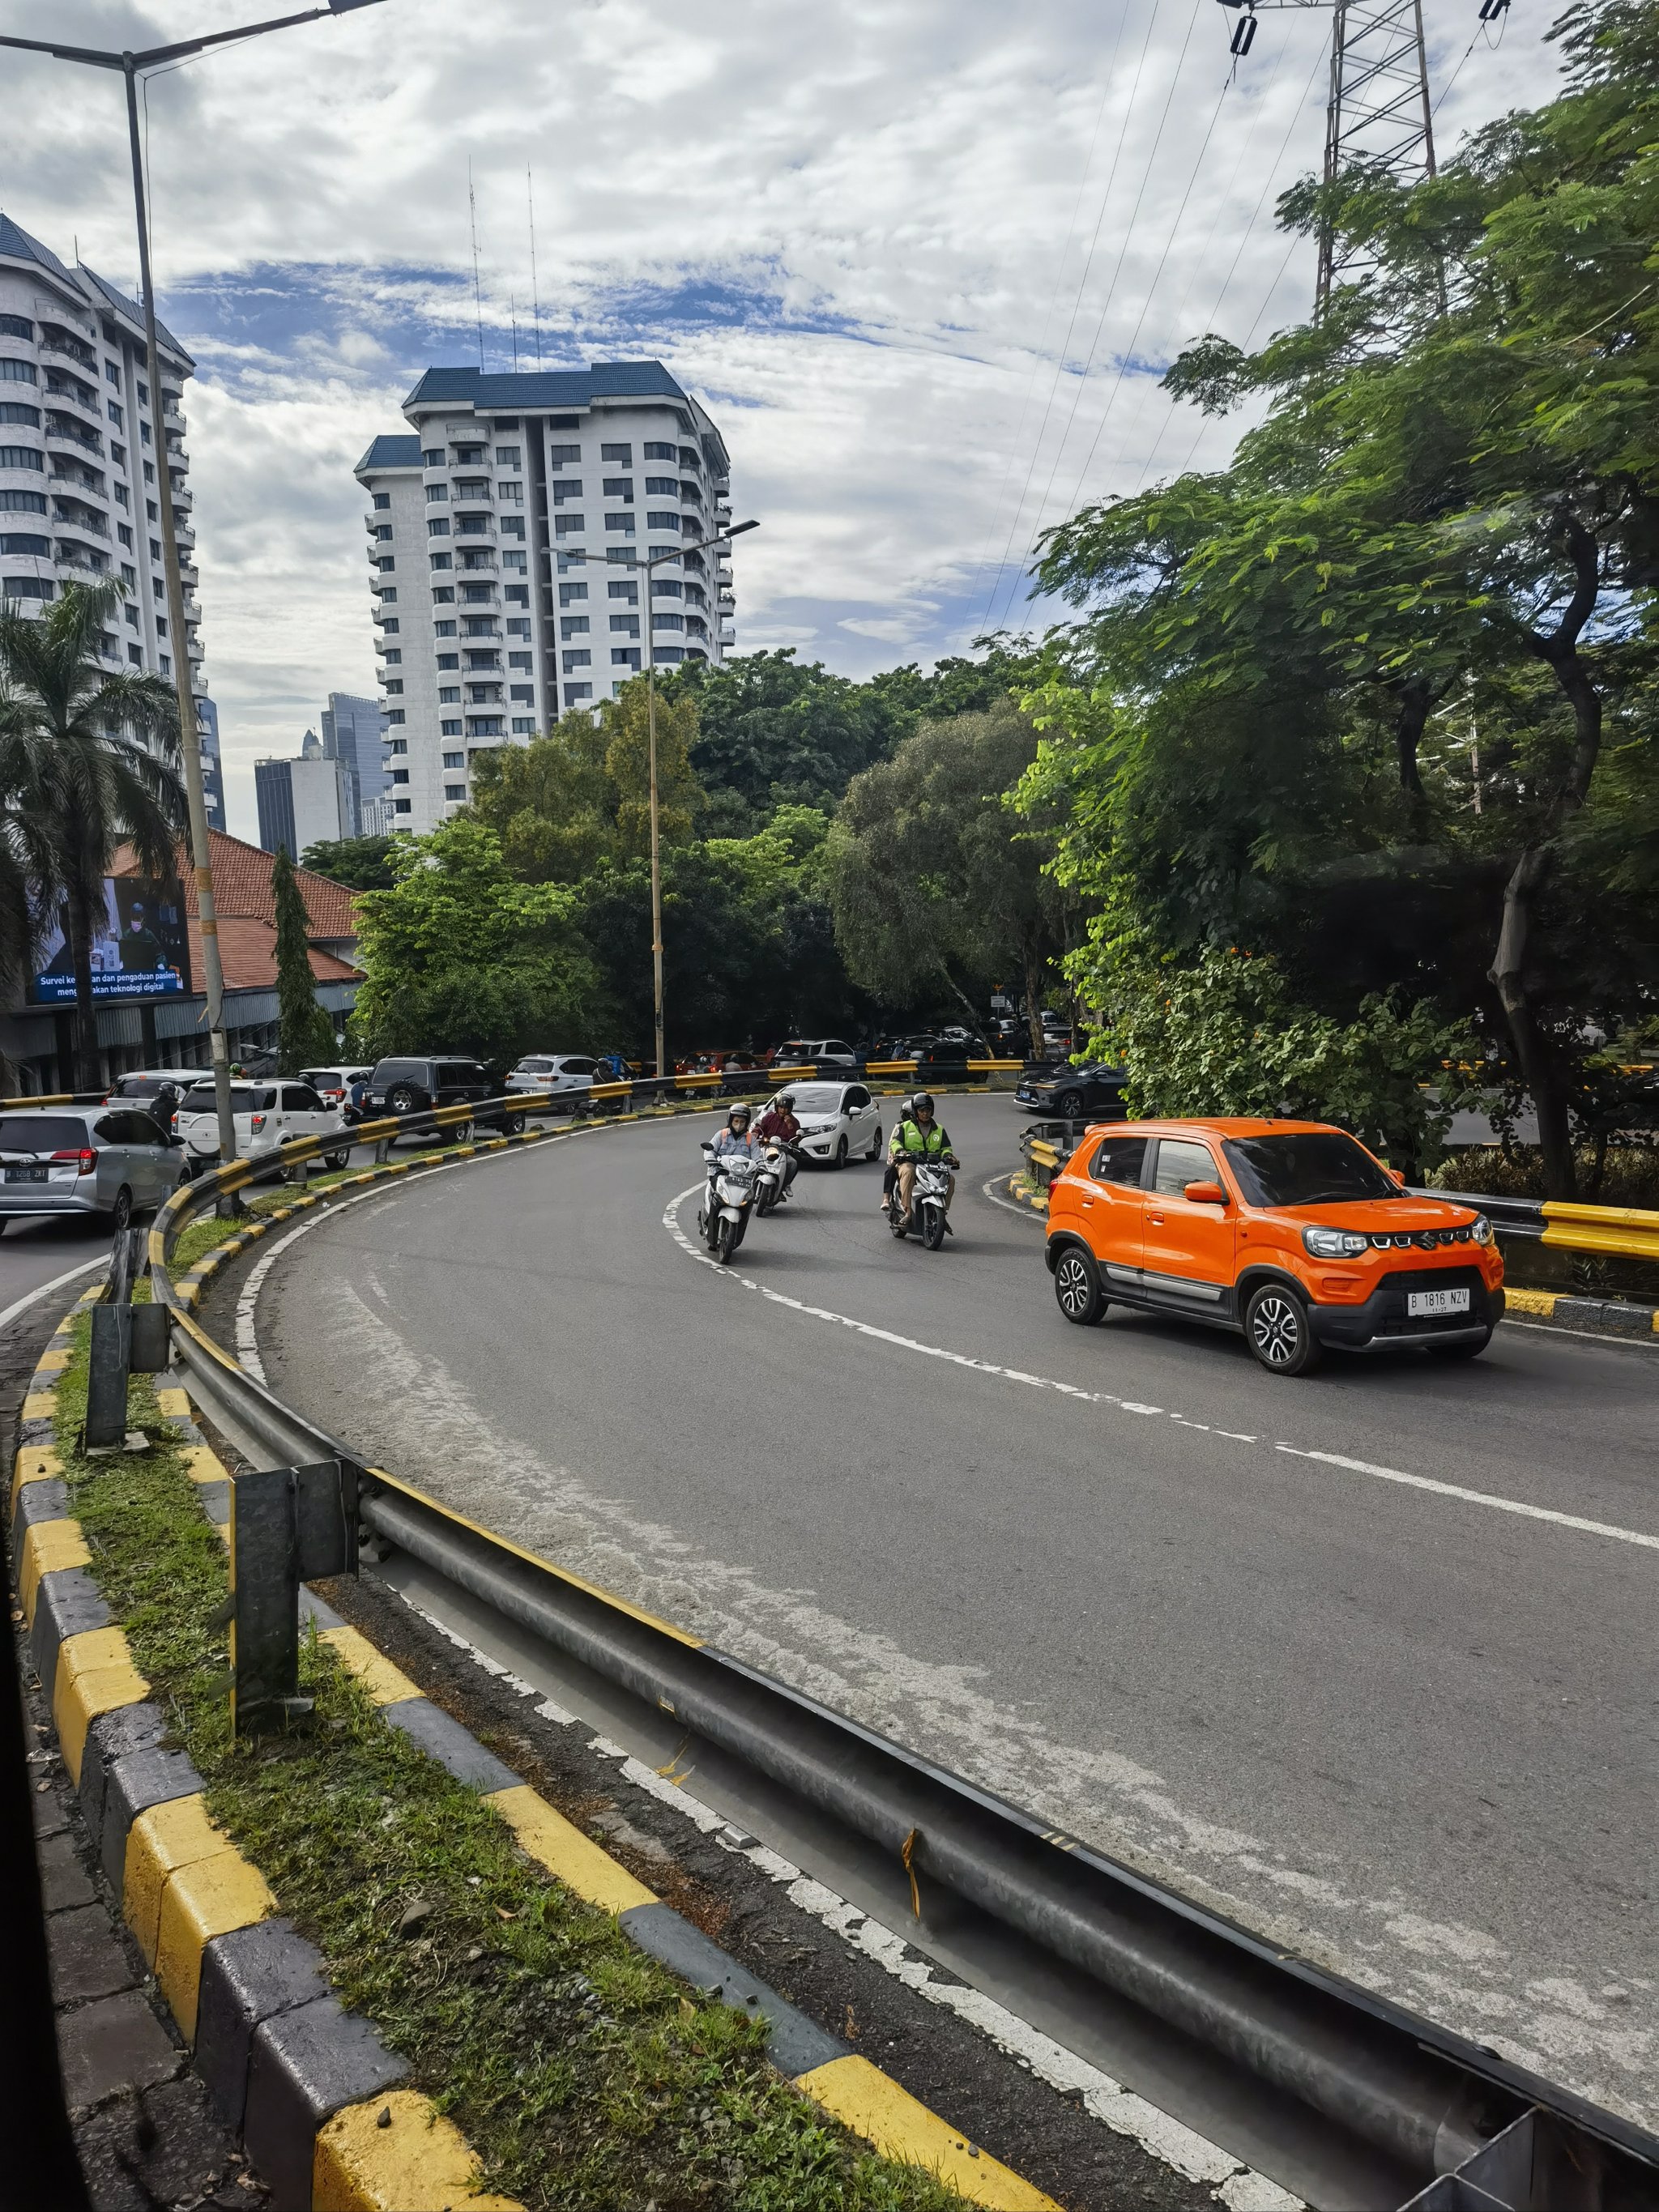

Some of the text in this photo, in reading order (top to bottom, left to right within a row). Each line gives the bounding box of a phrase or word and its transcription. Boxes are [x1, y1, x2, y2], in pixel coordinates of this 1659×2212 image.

[41, 971, 176, 985] Survei kean dan pengaduan pasien
[110, 983, 143, 992] teknologi
[143, 982, 164, 992] digital
[1411, 1290, 1467, 1308] B 1816 NZV
